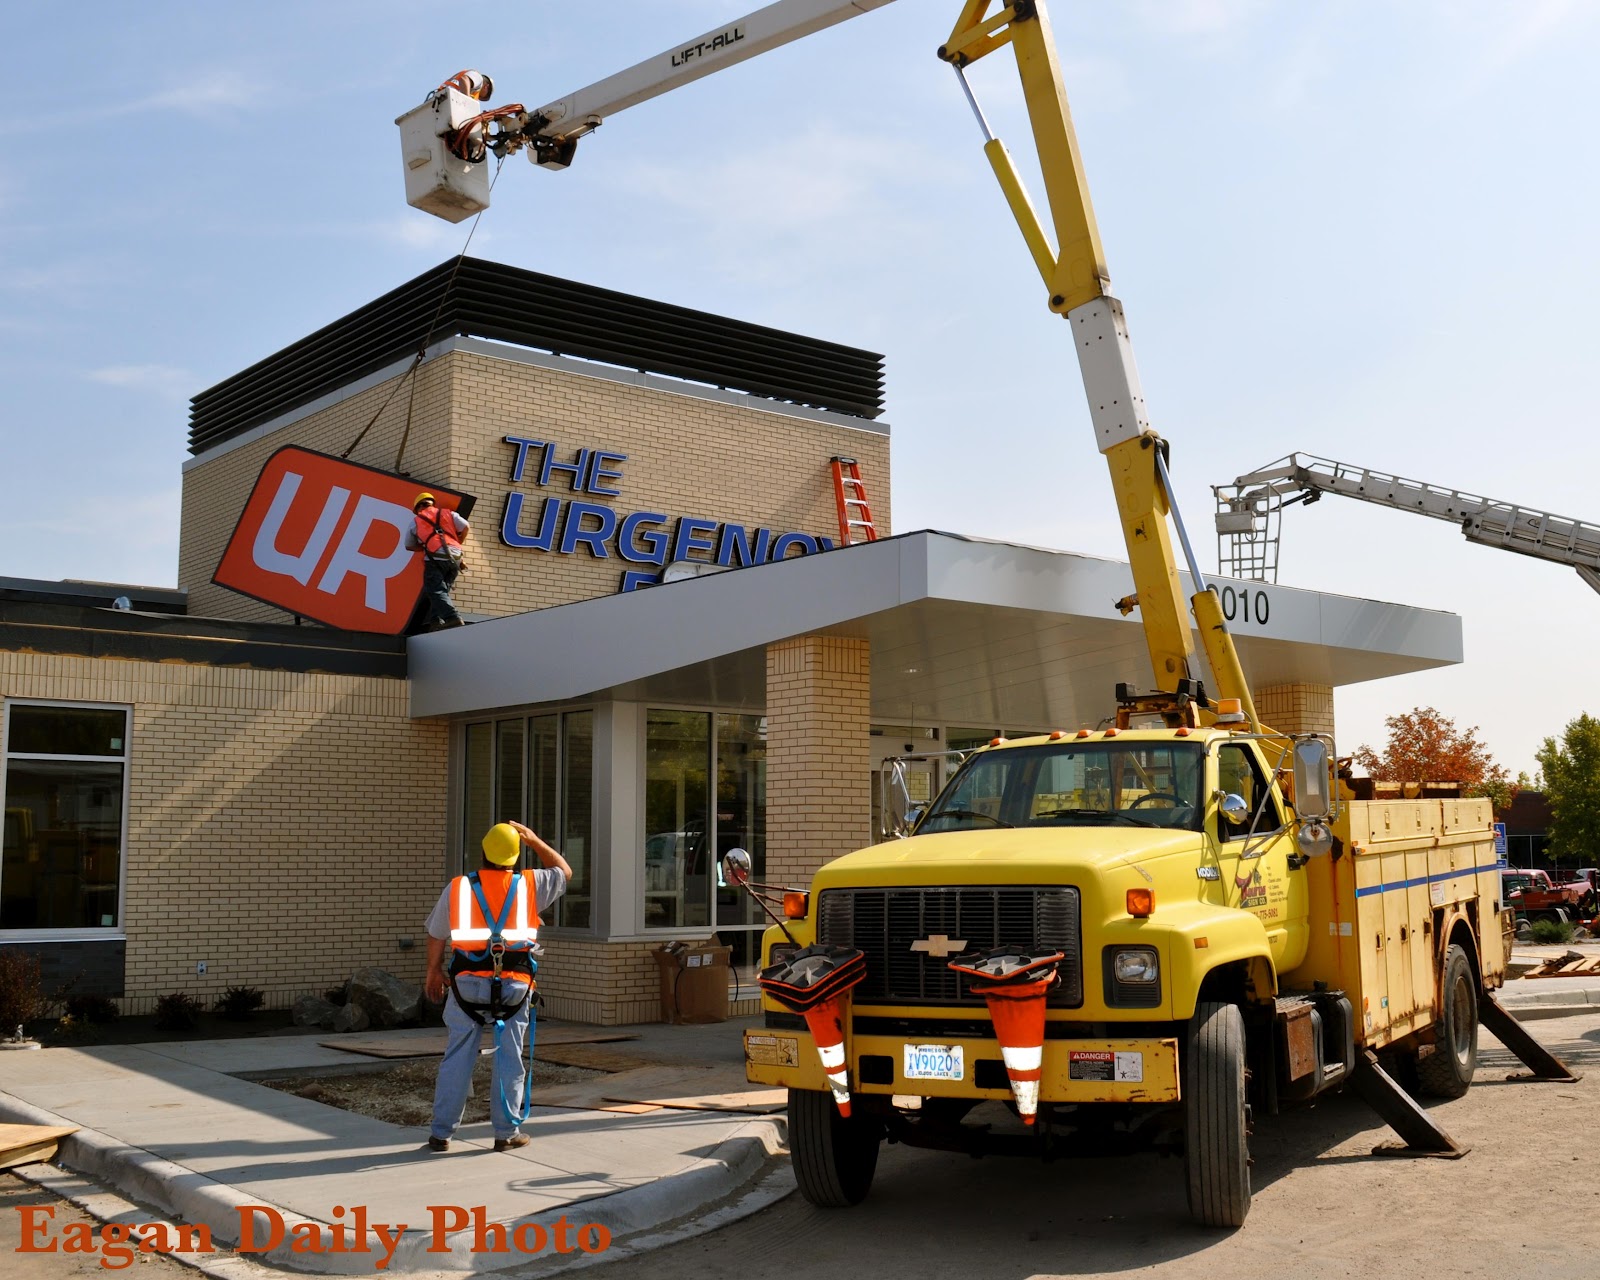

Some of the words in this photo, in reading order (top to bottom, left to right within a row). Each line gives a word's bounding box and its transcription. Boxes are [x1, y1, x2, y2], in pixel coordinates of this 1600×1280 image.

[671, 28, 745, 68] LIFT-ALL
[501, 435, 629, 496] THE
[252, 471, 417, 614] UR
[499, 491, 837, 567] URGEN
